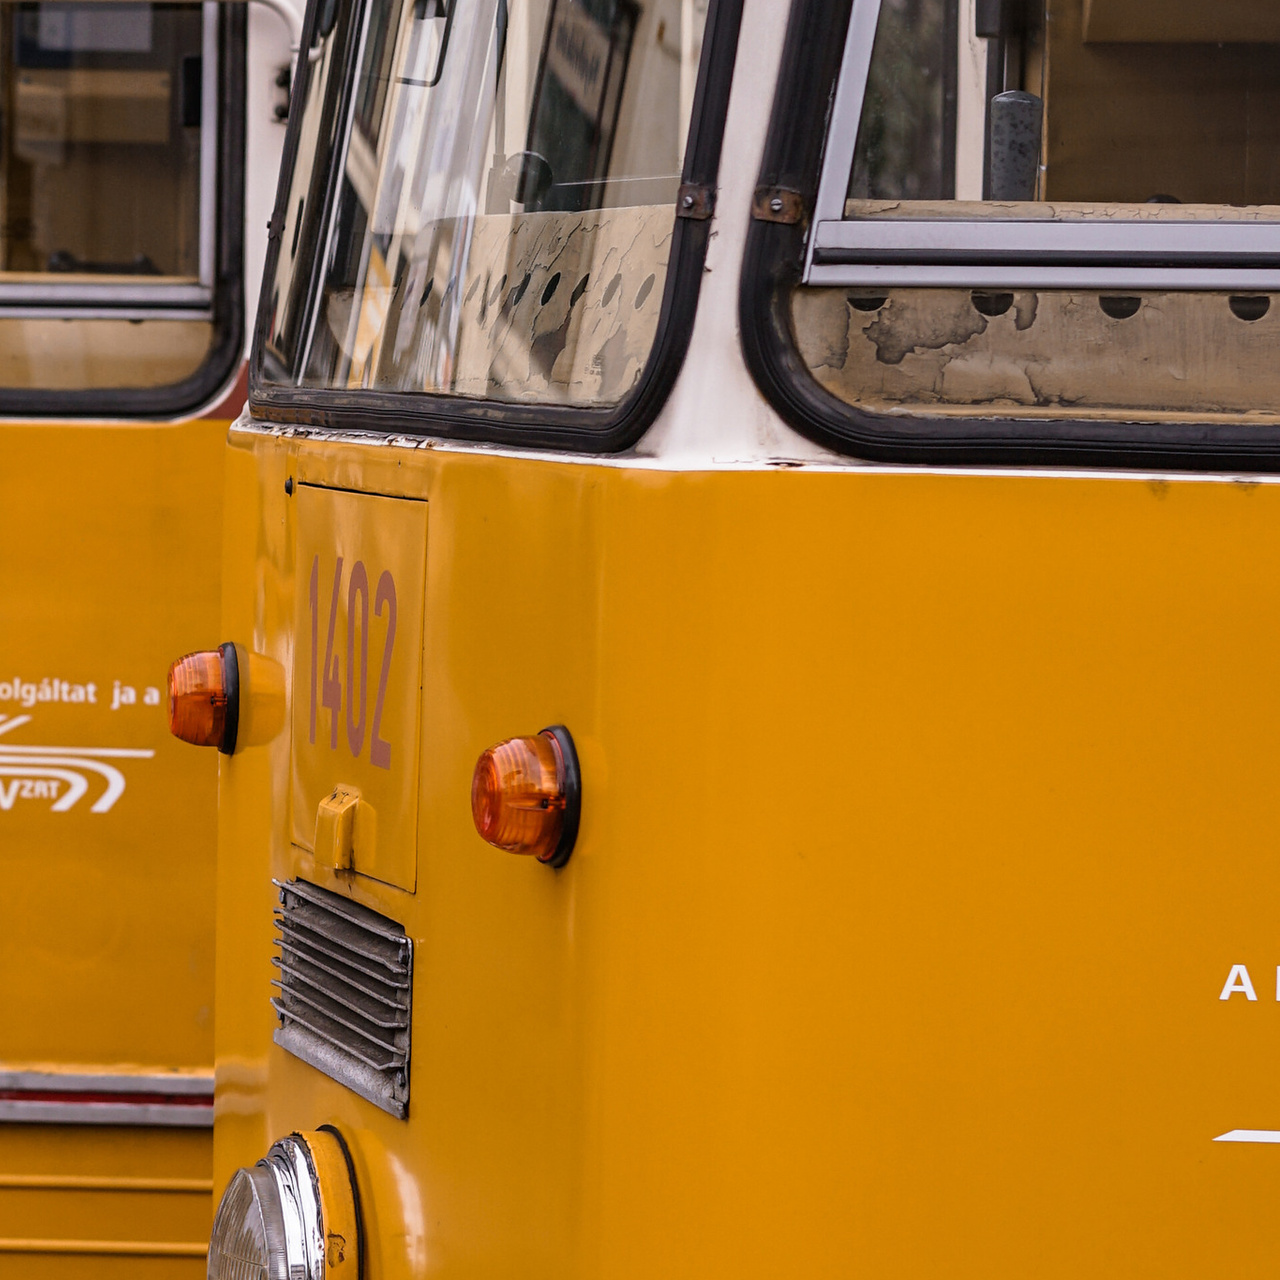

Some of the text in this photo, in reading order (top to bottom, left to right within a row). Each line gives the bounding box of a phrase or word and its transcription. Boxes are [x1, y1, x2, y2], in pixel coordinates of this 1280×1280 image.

[309, 554, 397, 771] 1402
[111, 680, 136, 710] ja
[143, 686, 160, 705] a
[1218, 964, 1258, 1001] A
